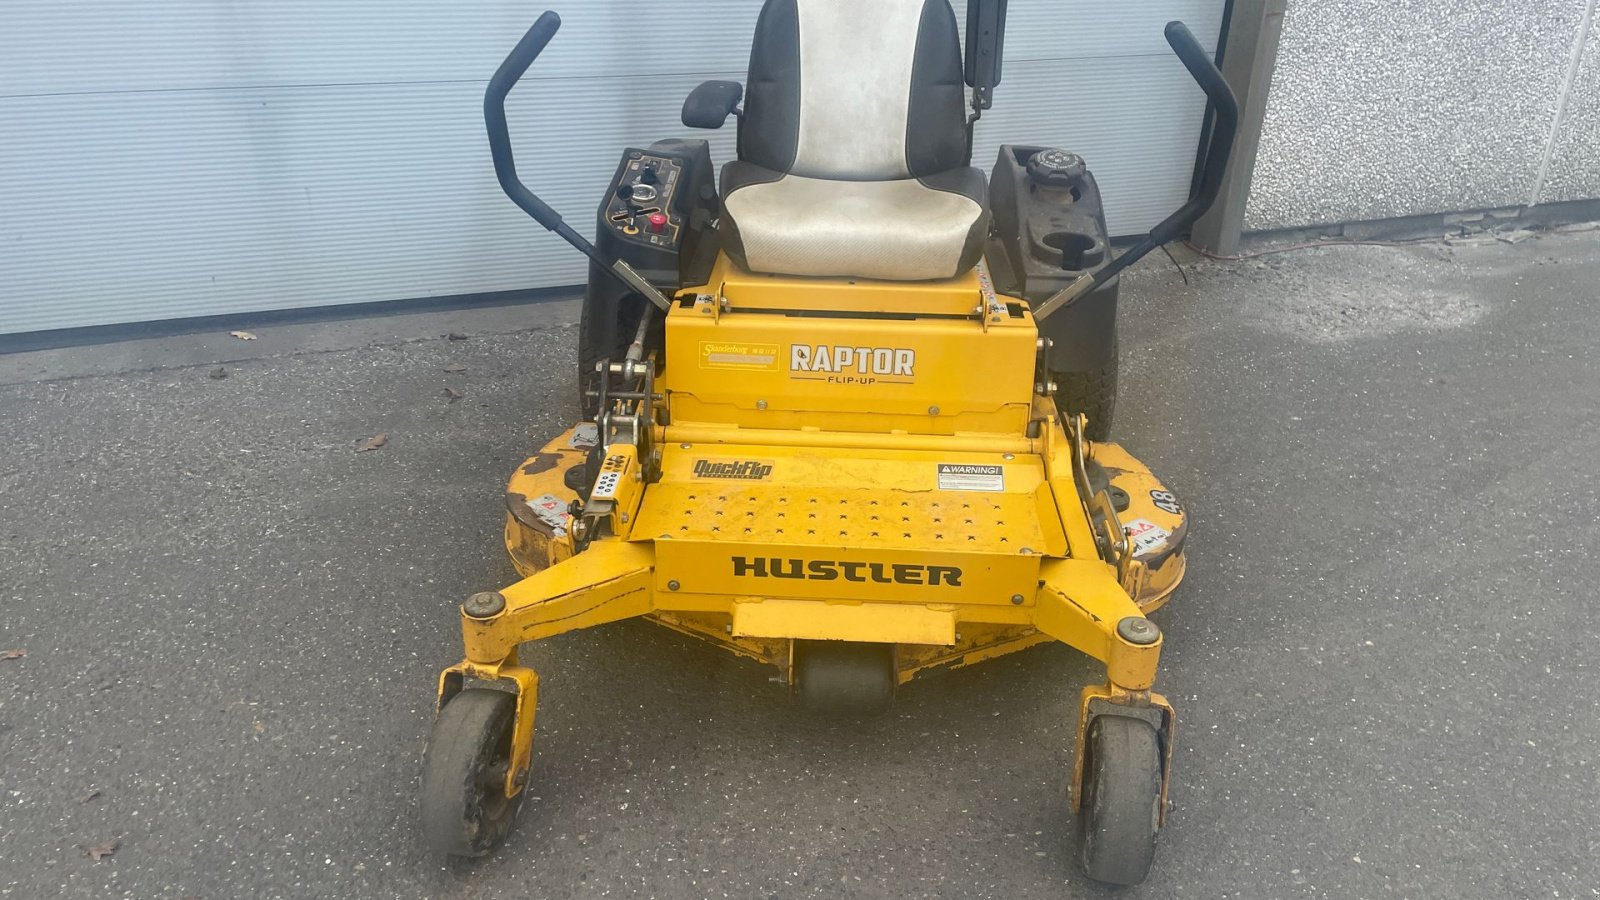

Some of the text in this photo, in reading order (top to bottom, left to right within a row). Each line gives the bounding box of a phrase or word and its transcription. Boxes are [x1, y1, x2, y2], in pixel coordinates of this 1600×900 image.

[790, 344, 915, 376] RAPTOR
[694, 460, 772, 479] QuickFlip
[951, 466, 999, 474] WARNING!
[1150, 490, 1181, 515] 48
[732, 556, 963, 587] HUSTLER
